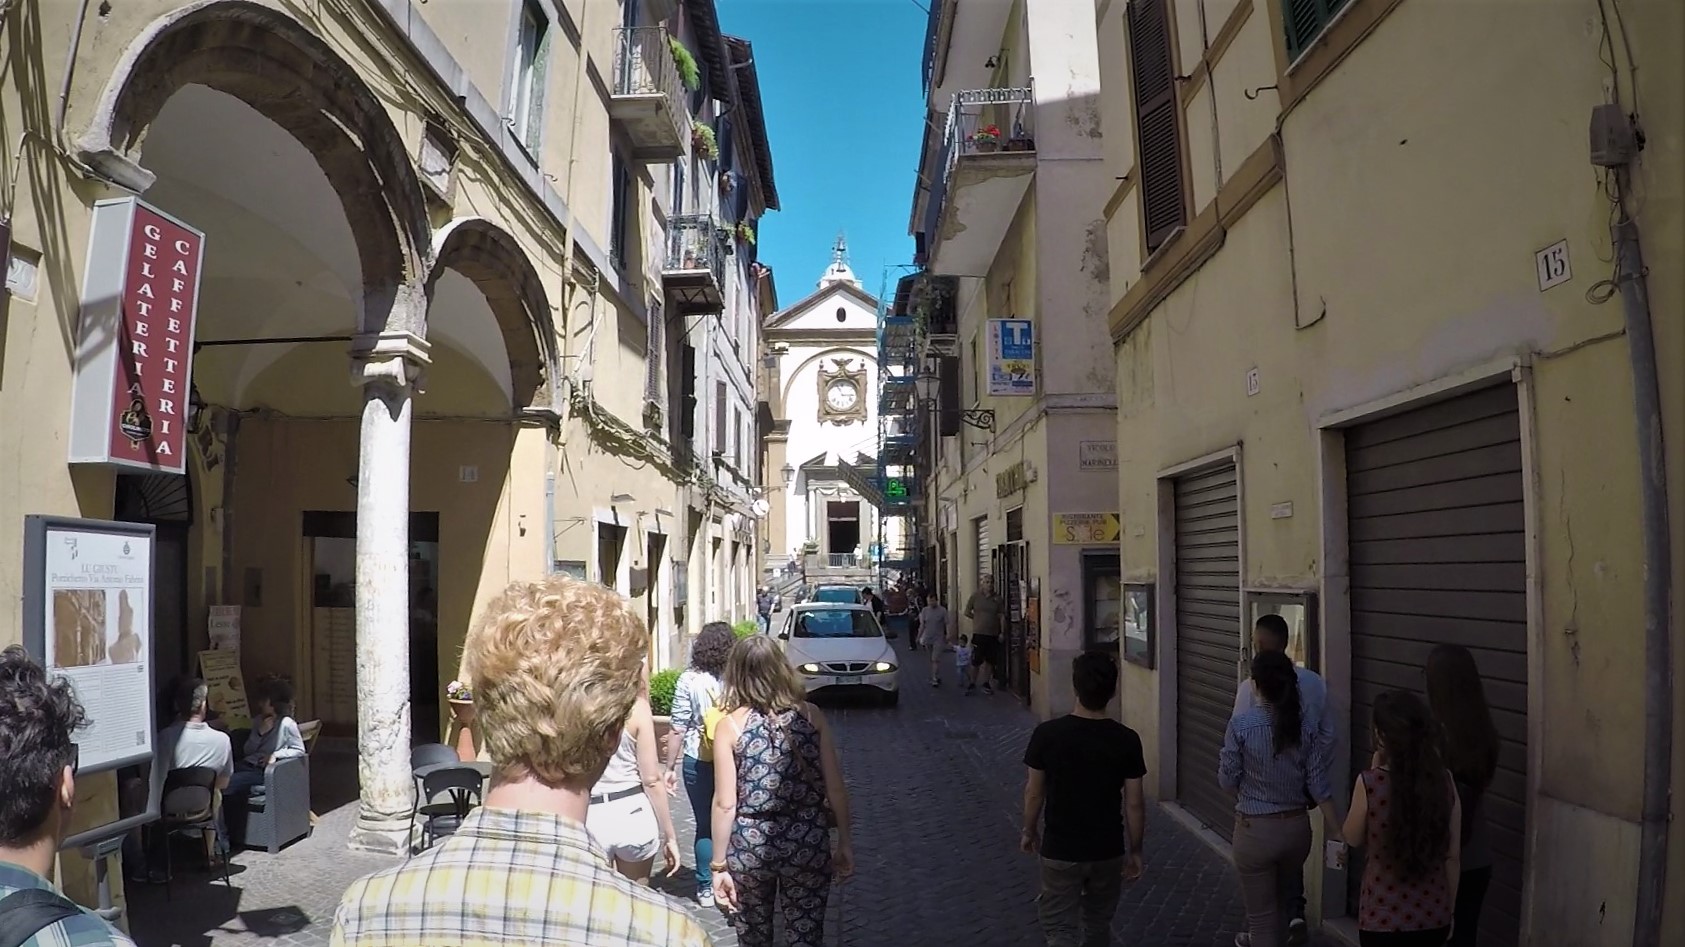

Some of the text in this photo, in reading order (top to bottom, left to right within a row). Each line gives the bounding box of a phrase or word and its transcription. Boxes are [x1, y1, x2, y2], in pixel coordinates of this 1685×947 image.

[127, 223, 161, 397] GELATERIA
[155, 239, 190, 456] CAFFETTERIA
[1005, 322, 1028, 345] T
